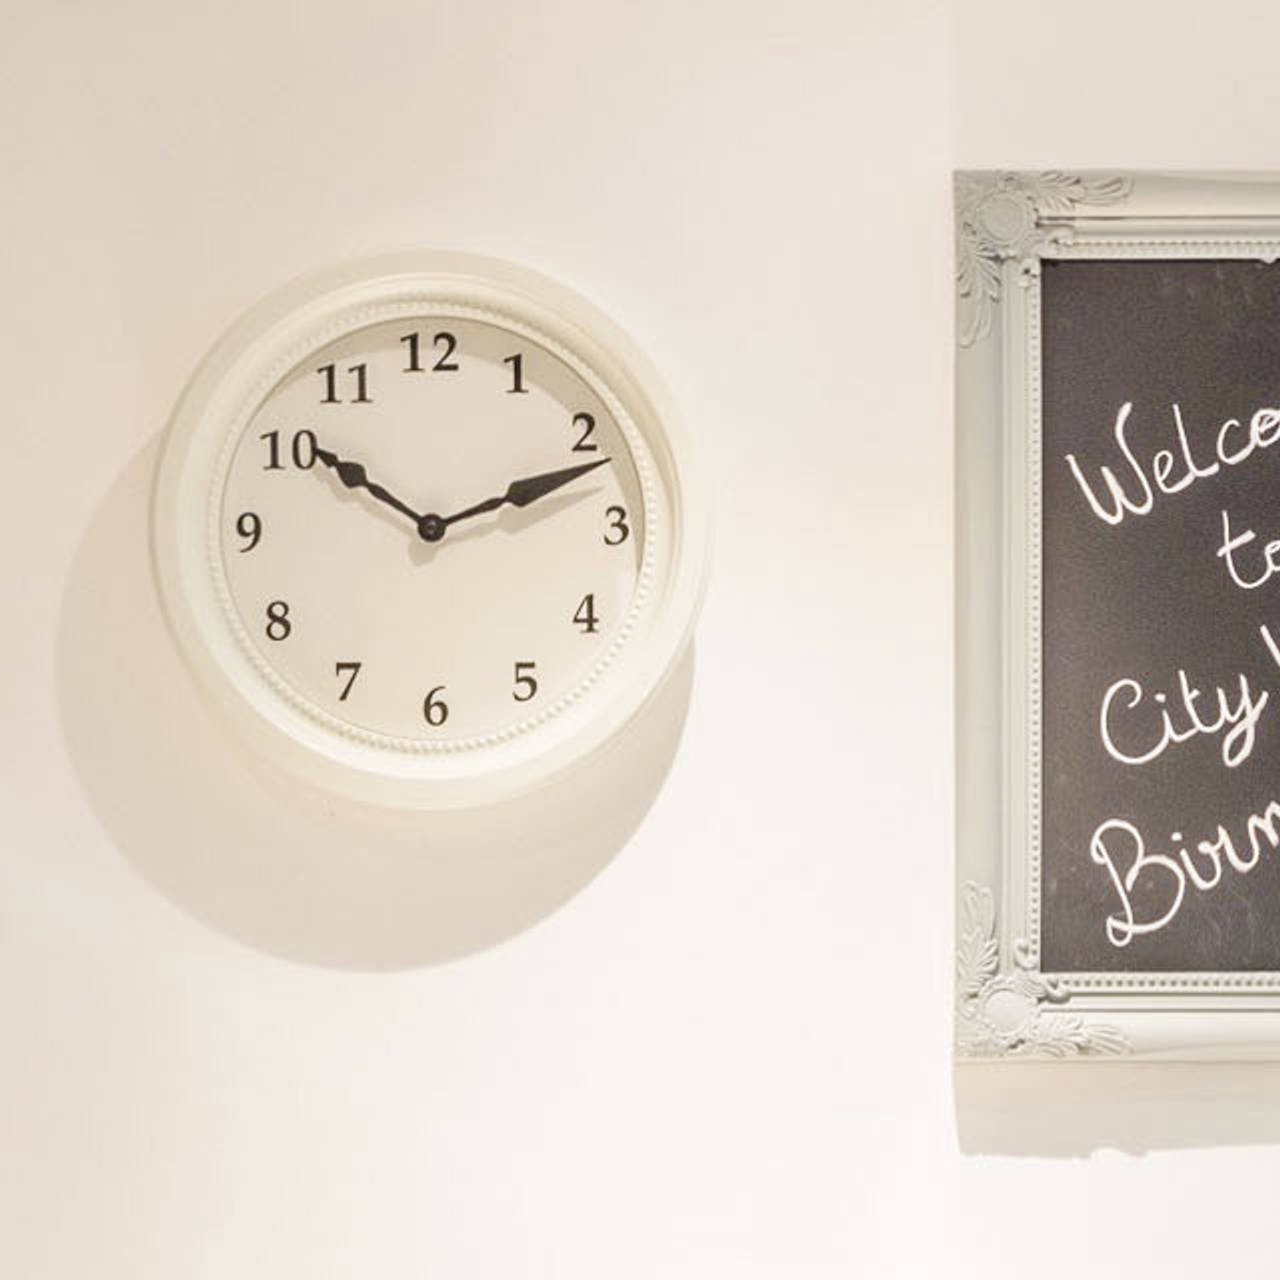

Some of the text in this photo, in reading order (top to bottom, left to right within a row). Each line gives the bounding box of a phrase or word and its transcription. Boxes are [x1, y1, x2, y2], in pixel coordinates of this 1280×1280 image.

[399, 331, 460, 372] 12
[316, 363, 373, 404] 11
[503, 353, 529, 394] 1
[260, 429, 319, 470] 10
[571, 412, 598, 452] 2
[235, 512, 262, 553] 9
[603, 505, 630, 546] 3
[265, 600, 292, 642] 8
[572, 593, 599, 634] 4
[335, 662, 362, 702] 7
[512, 661, 538, 702] 5
[423, 685, 450, 726] 6
[1098, 669, 1270, 768] City
